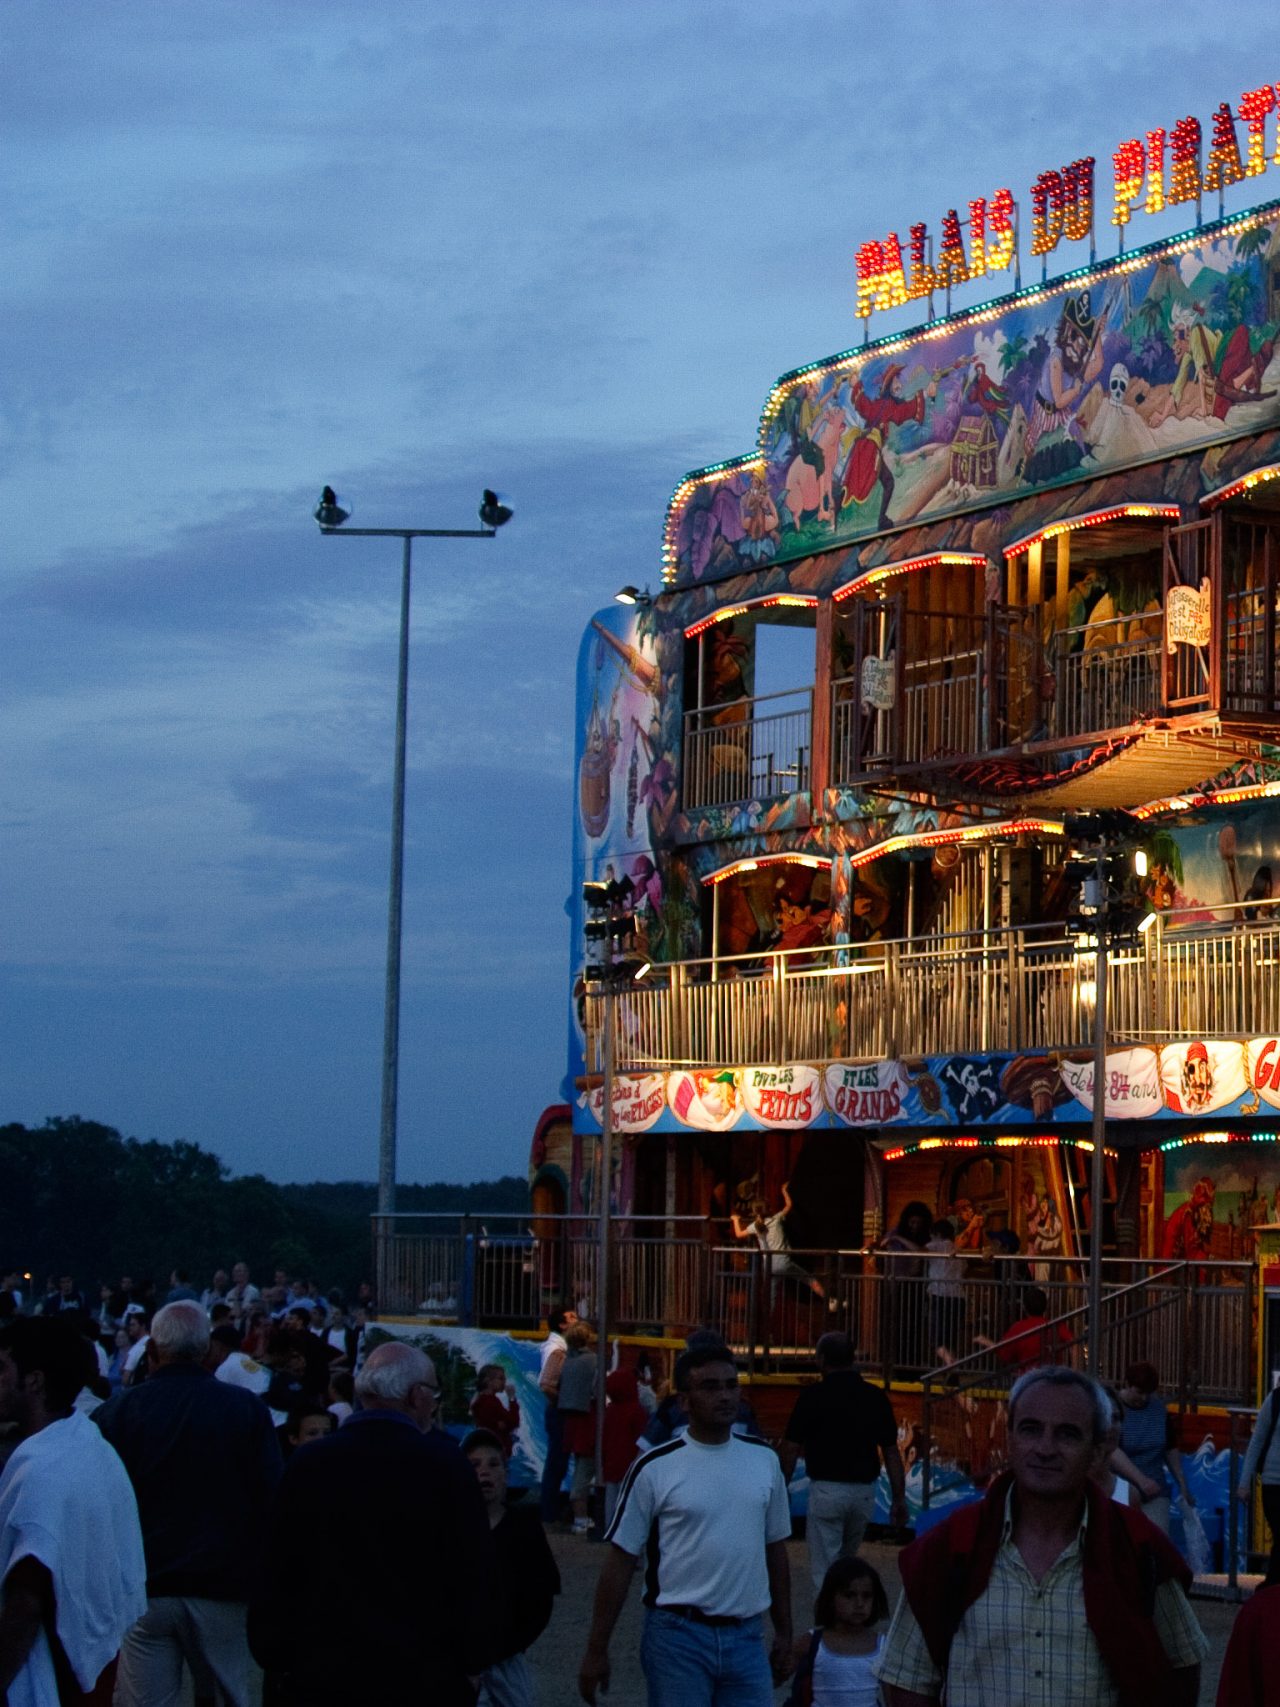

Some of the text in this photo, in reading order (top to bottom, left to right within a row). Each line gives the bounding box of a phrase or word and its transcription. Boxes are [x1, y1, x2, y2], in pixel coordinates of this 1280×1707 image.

[855, 188, 1015, 318] PALAIS
[1030, 158, 1098, 256] DU
[754, 1082, 812, 1121] PETITS
[835, 1078, 901, 1122] GRANDS
